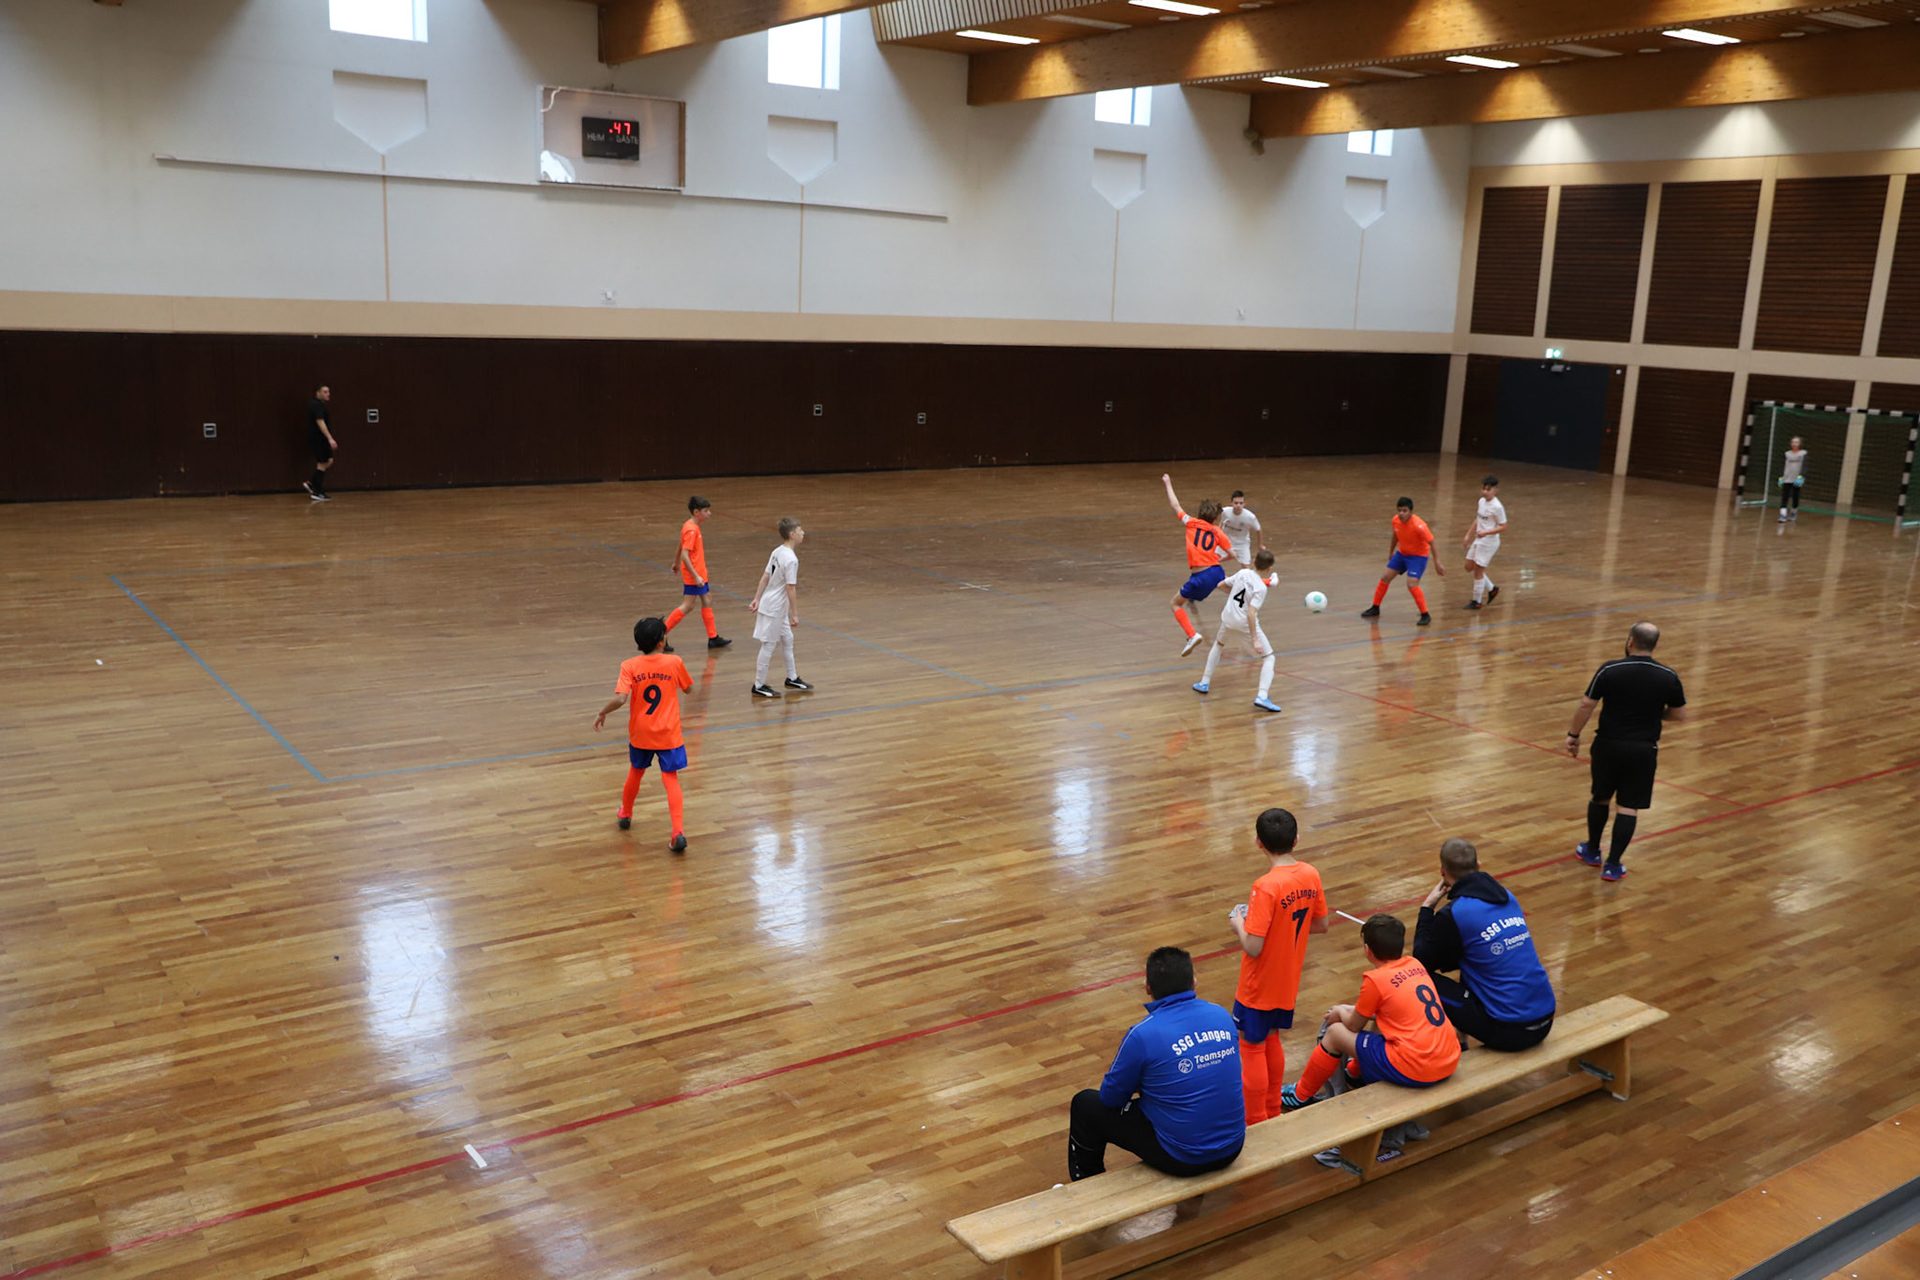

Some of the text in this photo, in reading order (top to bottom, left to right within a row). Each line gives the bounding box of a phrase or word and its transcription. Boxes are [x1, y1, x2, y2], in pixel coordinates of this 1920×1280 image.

[1194, 528, 1215, 551] 10
[1233, 588, 1247, 608] 4
[633, 672, 672, 683] SSG Langen
[643, 684, 662, 715] 9
[1281, 892, 1296, 909] SSG
[1292, 907, 1309, 951] 7
[1481, 922, 1501, 941] SSG
[1390, 972, 1407, 988] SSG
[1416, 984, 1445, 1027] 8
[1172, 1030, 1231, 1056] SSG Langen
[1194, 1046, 1236, 1064] Teamsport
